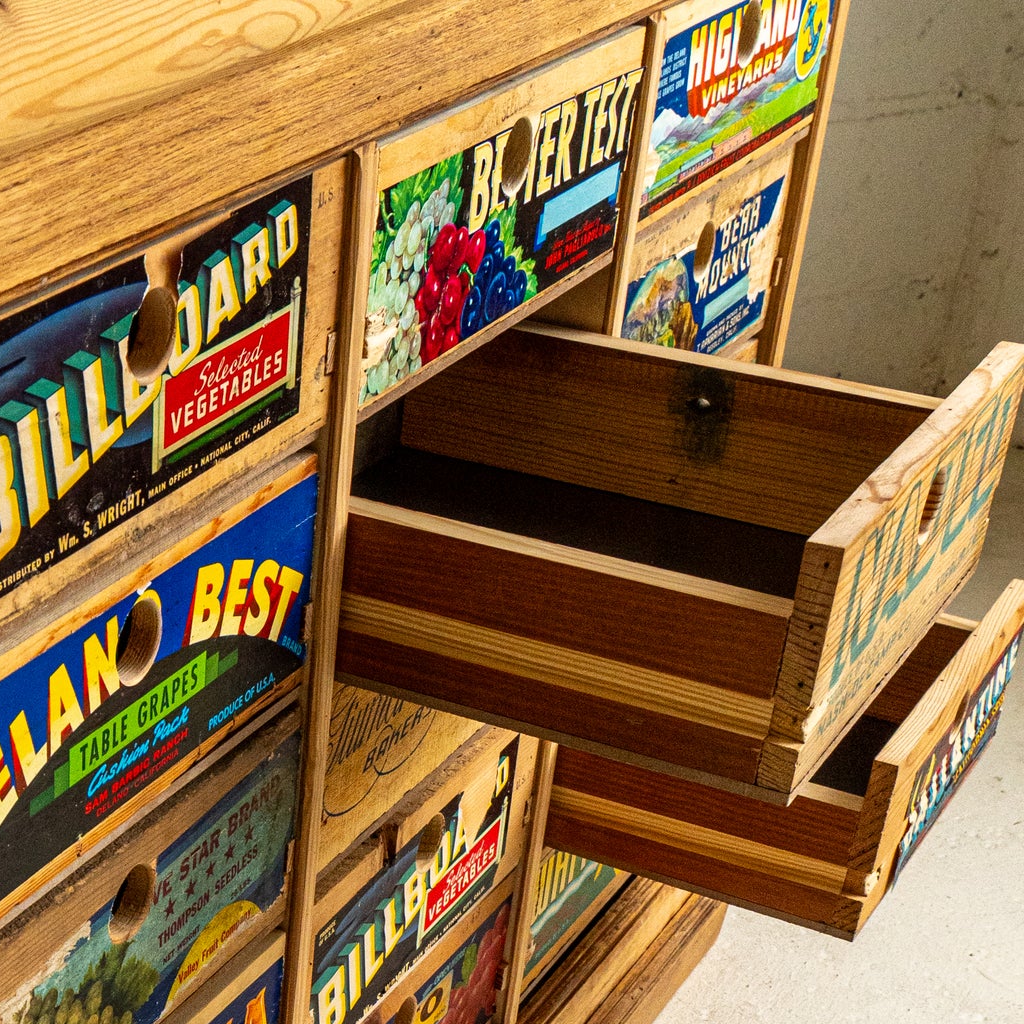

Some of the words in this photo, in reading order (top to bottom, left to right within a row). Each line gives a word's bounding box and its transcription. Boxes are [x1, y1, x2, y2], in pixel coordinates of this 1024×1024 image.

[702, 46, 783, 109] VINEYARDS
[578, 67, 645, 174] TEST
[720, 195, 762, 252] BEAR
[170, 349, 283, 434] VEGETABLES
[194, 335, 264, 396] Selected
[44, 549, 55, 564] BY
[58, 534, 80, 555] Wm.
[83, 522, 94, 538] S.
[97, 489, 145, 531] WRIGHT,
[148, 481, 167, 499] MAIN
[169, 468, 193, 486] OFFICE
[200, 446, 233, 467] NATIONAL
[234, 429, 251, 446] CITY,
[252, 416, 273, 436] CALIF.
[186, 558, 304, 646] BEST
[282, 633, 303, 657] BRAND
[79, 713, 128, 772] TABLE
[137, 663, 198, 729] GRAPES
[208, 695, 244, 731] PRODUCE
[244, 686, 256, 704] OF
[256, 672, 276, 696] U.S.A.
[85, 791, 108, 816] SAM
[153, 727, 189, 763] RANCH
[87, 739, 150, 798] Cushion
[153, 705, 190, 747] Pack
[96, 786, 129, 818] DELANO
[134, 749, 180, 789] CALIFORNIA
[179, 827, 221, 882] STAR
[428, 843, 496, 920] VEGETABLES
[444, 840, 485, 892] Selected
[157, 889, 210, 949] THOMPSON
[214, 845, 259, 895] SEEDLESS
[201, 937, 220, 963] Fruit
